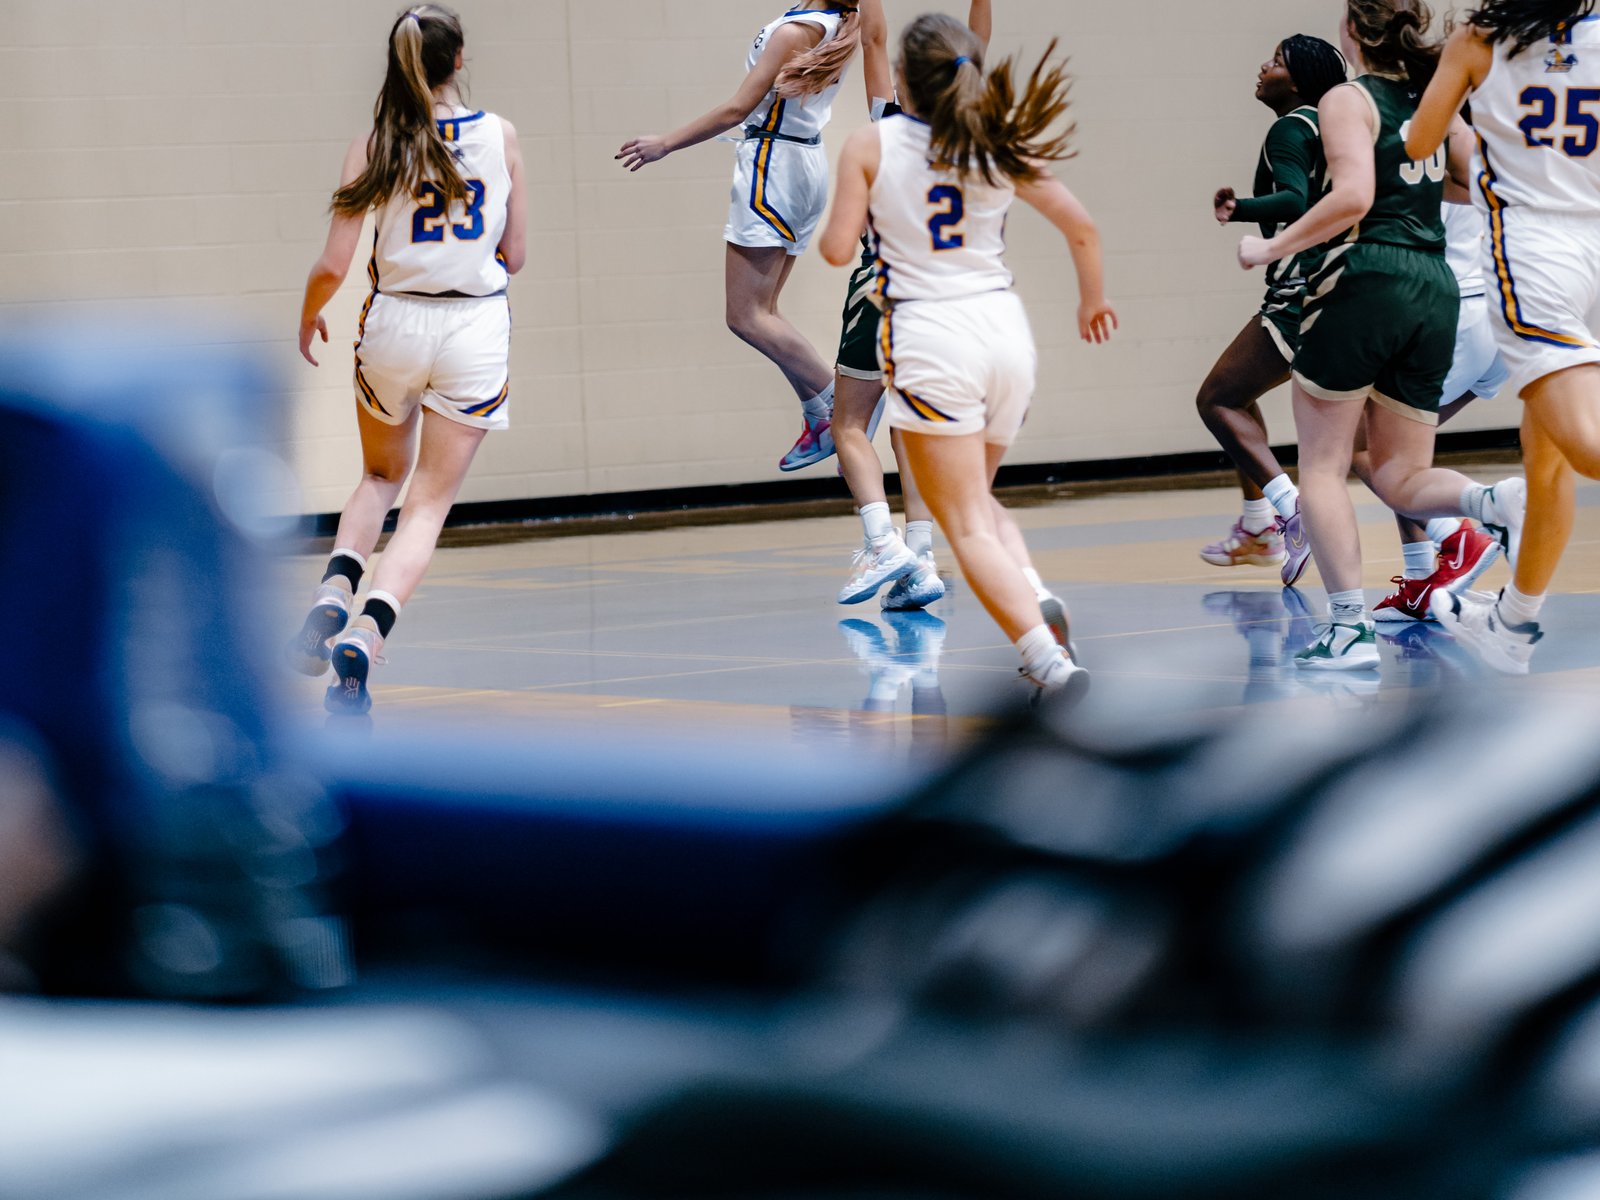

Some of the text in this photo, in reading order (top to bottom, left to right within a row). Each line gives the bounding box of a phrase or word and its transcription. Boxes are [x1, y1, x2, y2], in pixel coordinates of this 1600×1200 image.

[1517, 84, 1600, 158] 25
[409, 178, 487, 246] 23
[926, 181, 967, 253] 2
